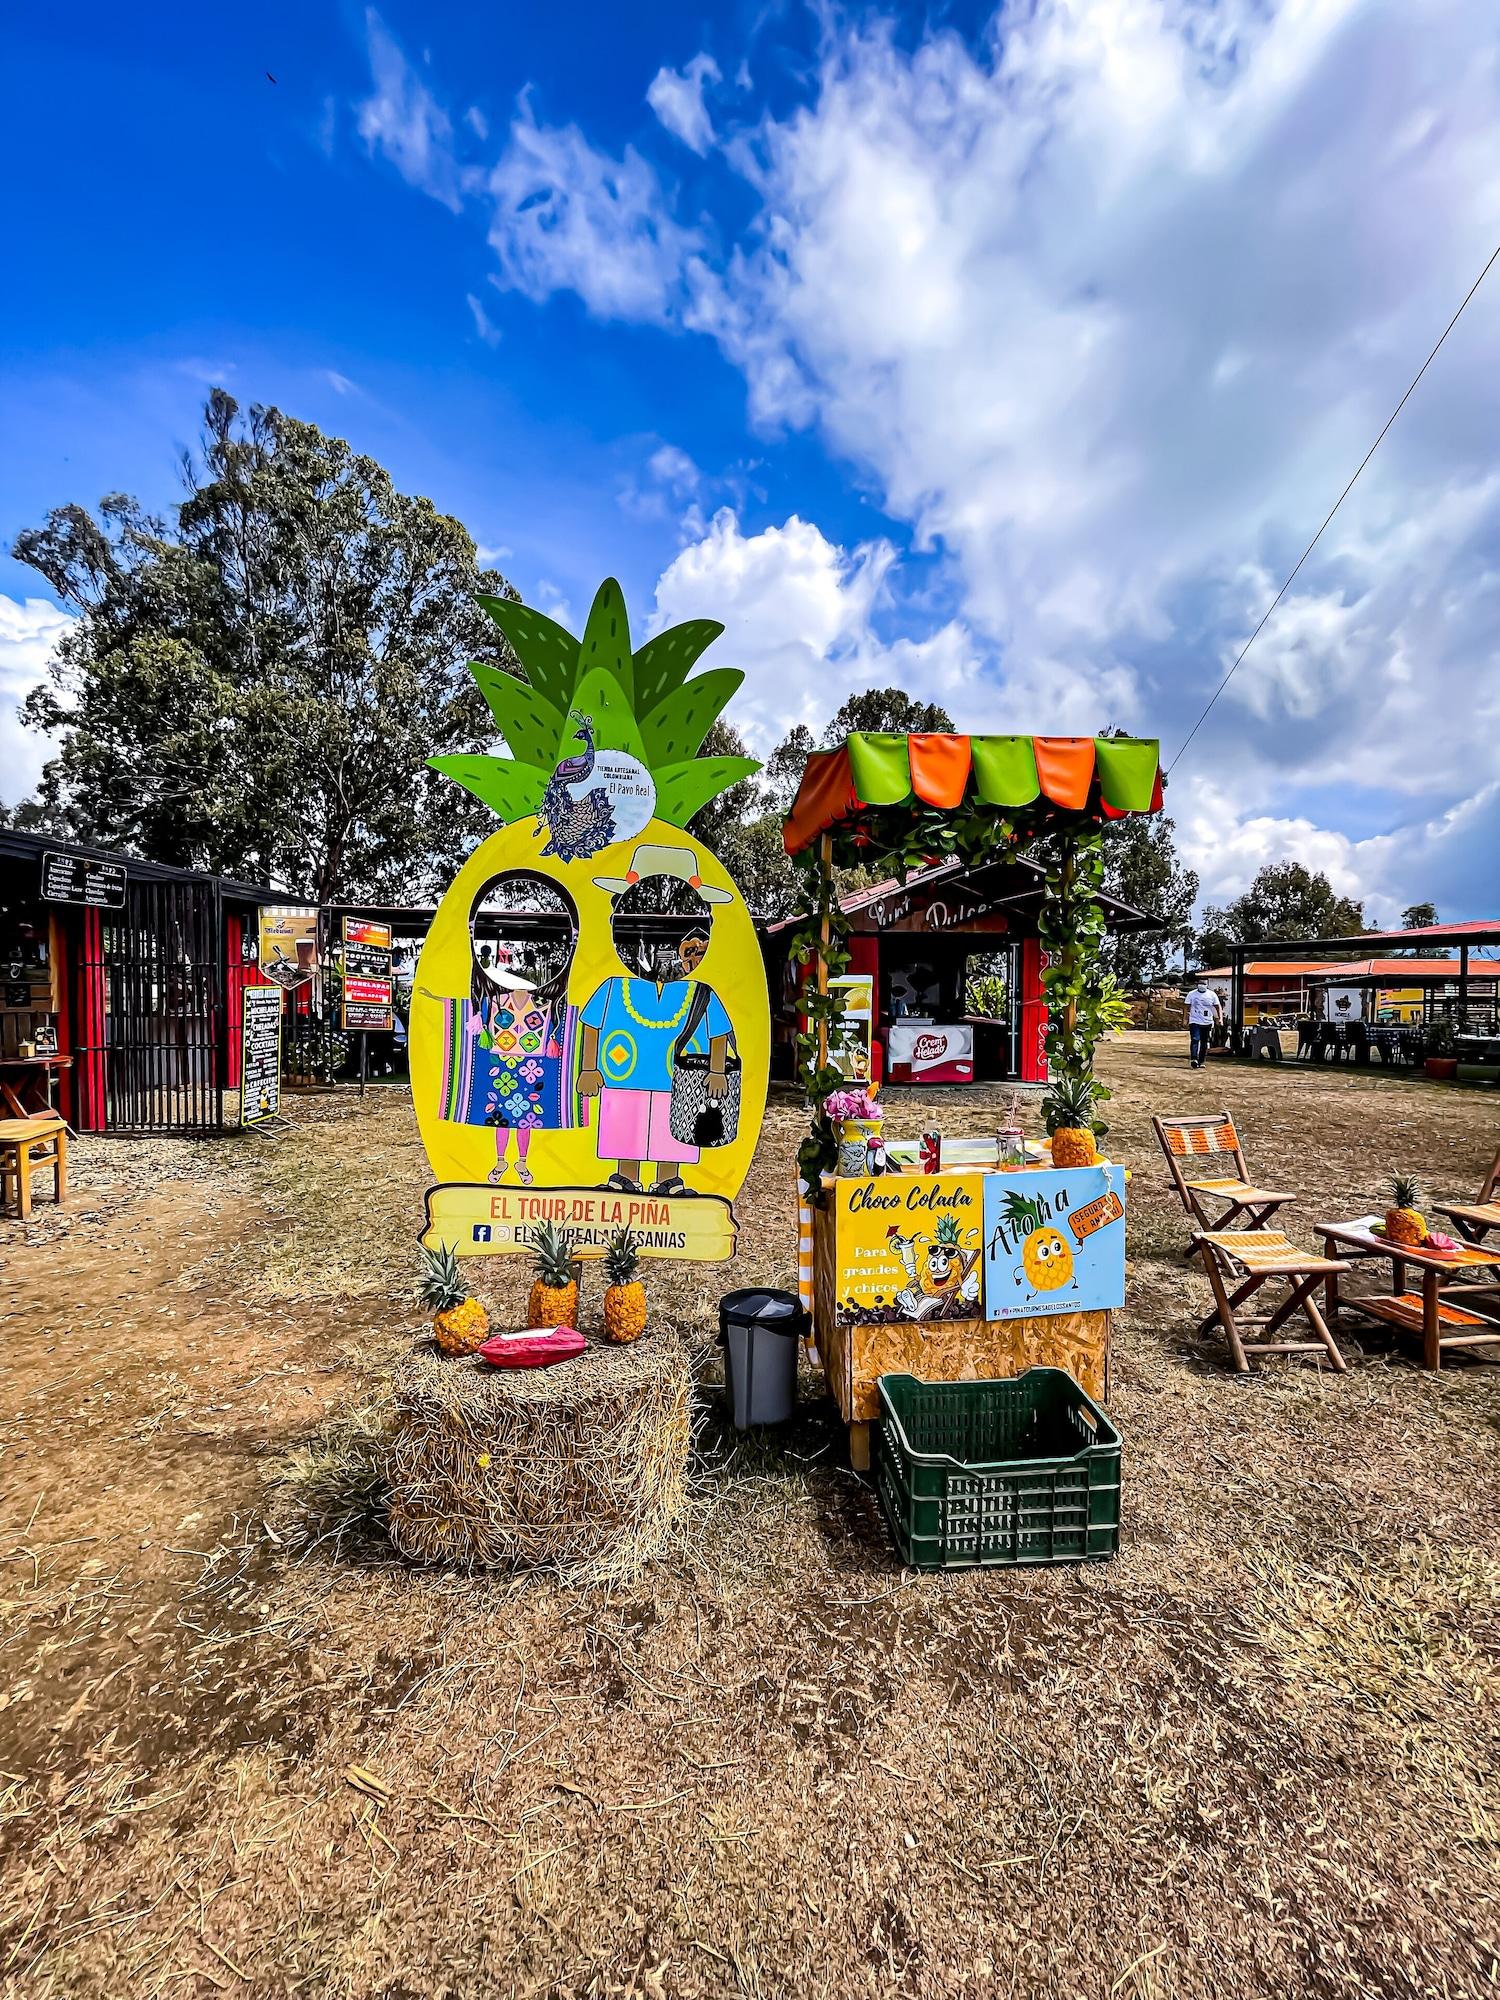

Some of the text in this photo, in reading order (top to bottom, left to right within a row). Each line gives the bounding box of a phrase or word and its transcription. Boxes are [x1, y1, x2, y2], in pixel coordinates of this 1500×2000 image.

[597, 765, 613, 773] TIENDA
[603, 773, 633, 781] COLOMBIANA
[609, 782, 650, 797] El Pavo Real
[346, 952, 389, 963] COCKTAILS
[251, 1040, 278, 1050] COCKTAILS
[920, 1037, 943, 1047] Crem
[915, 1045, 945, 1060] Helado
[848, 1182, 973, 1213] Choco Colada
[490, 1196, 671, 1225] EL TOUR DE LA PIÑA
[1077, 1224, 1087, 1235] TE
[855, 1247, 887, 1258] Para
[843, 1265, 899, 1279] grandes
[842, 1283, 899, 1297] y chicos
